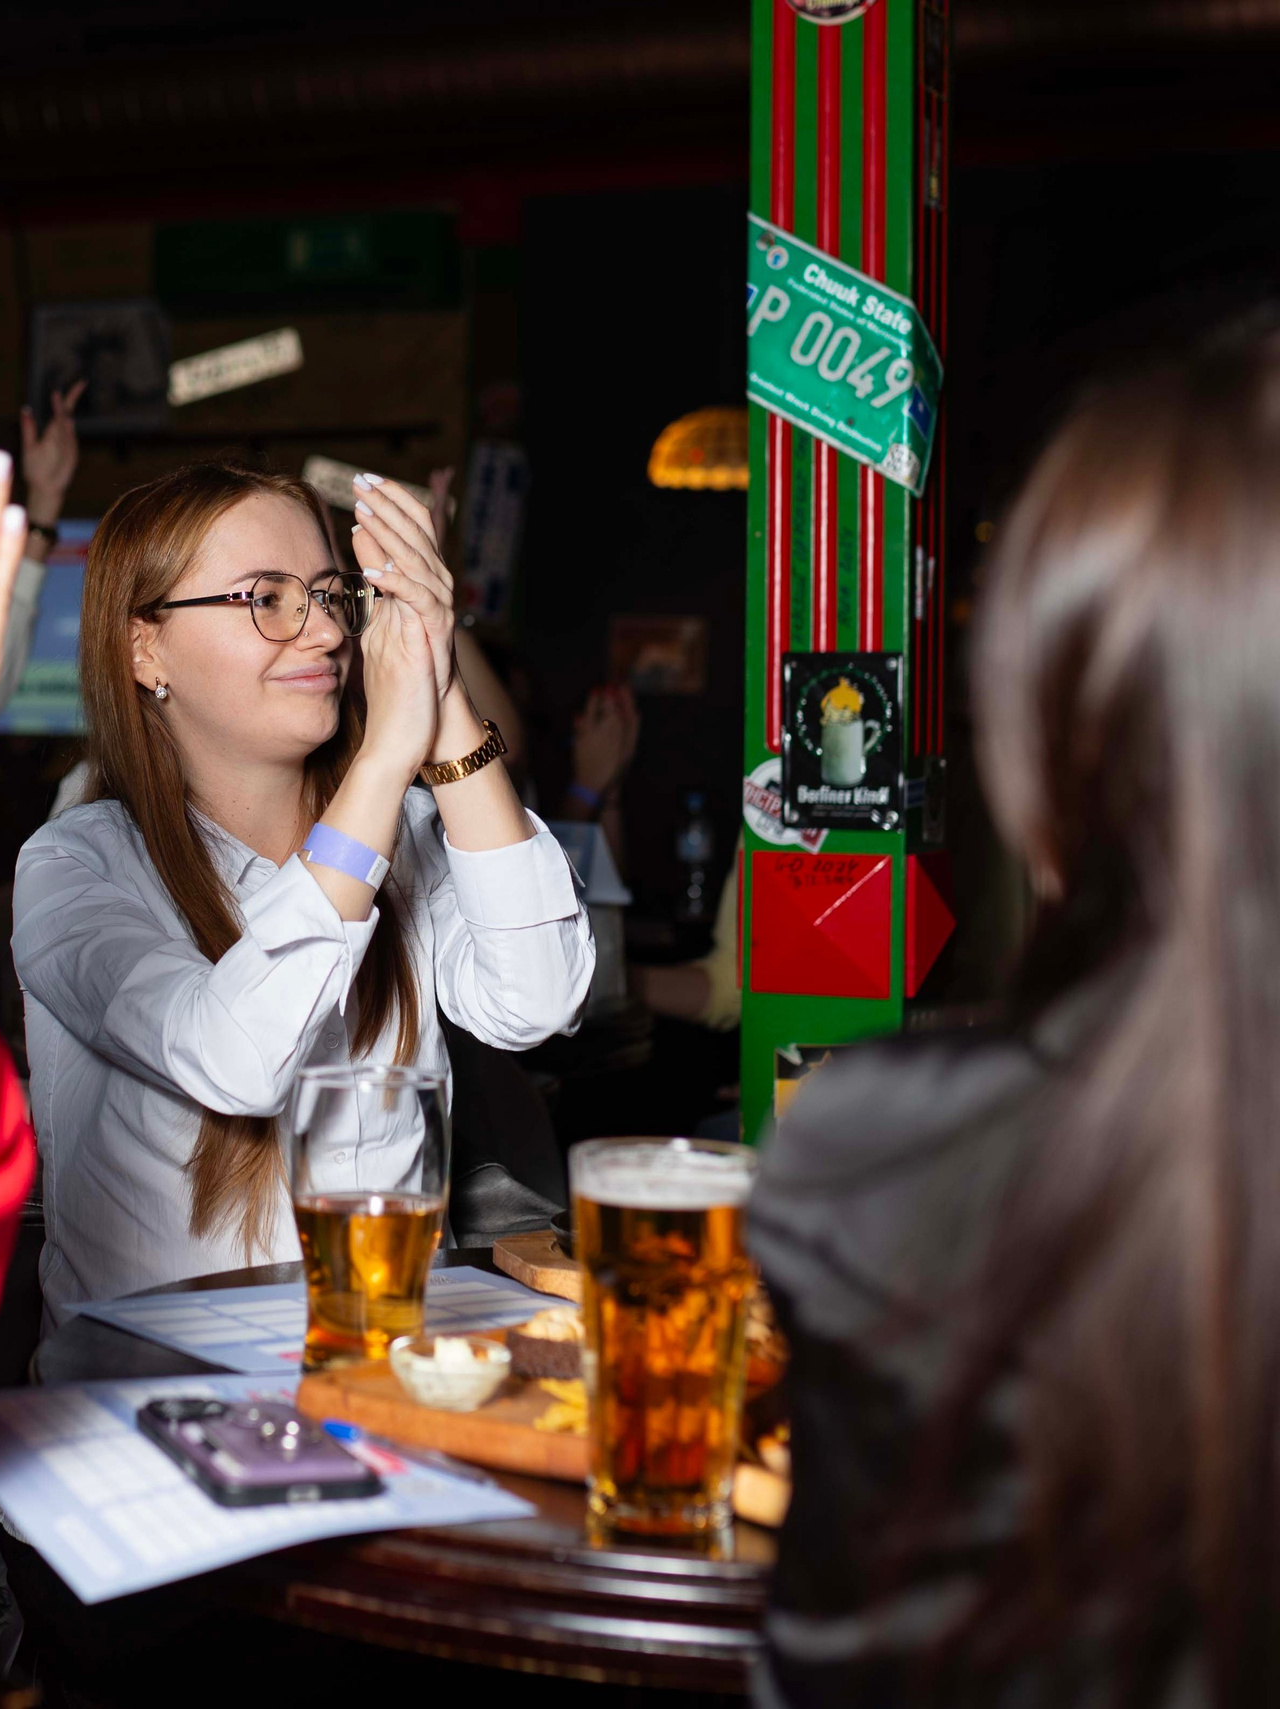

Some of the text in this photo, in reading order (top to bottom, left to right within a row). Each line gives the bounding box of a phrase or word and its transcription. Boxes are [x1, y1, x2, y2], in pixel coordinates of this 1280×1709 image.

[746, 284, 914, 408] P 0049
[803, 263, 912, 335] Chuuk State
